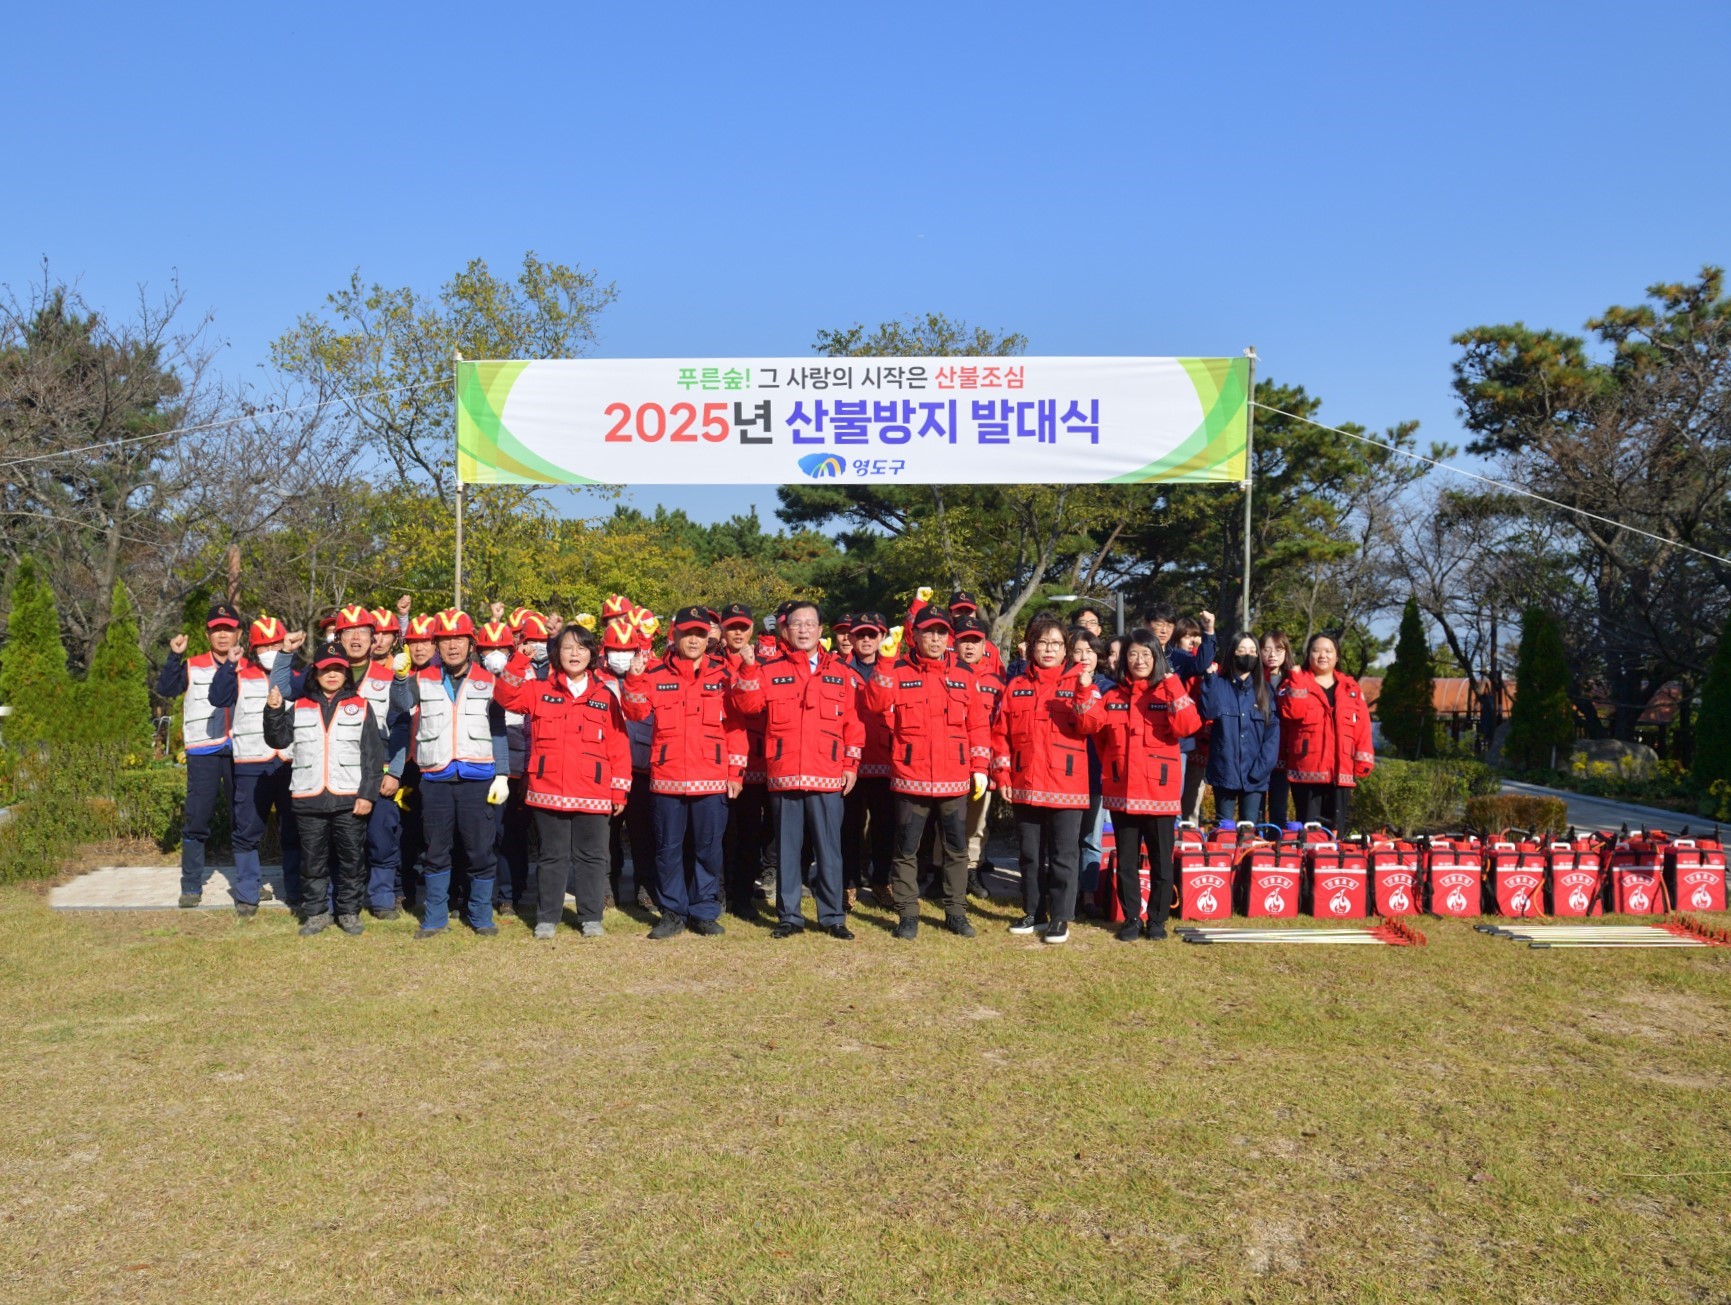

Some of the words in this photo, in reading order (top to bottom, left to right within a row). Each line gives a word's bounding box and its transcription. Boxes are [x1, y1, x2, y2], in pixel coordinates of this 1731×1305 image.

[678, 367, 750, 390] 푸른숲!
[758, 368, 780, 389] 그
[786, 367, 853, 390] 사랑의
[860, 367, 928, 390] 시작은
[934, 366, 1024, 389] 산불조심
[604, 400, 774, 445] 2025년
[785, 400, 957, 445] 산불방지
[971, 399, 1099, 445] 발대식
[853, 459, 906, 477] 영도구
